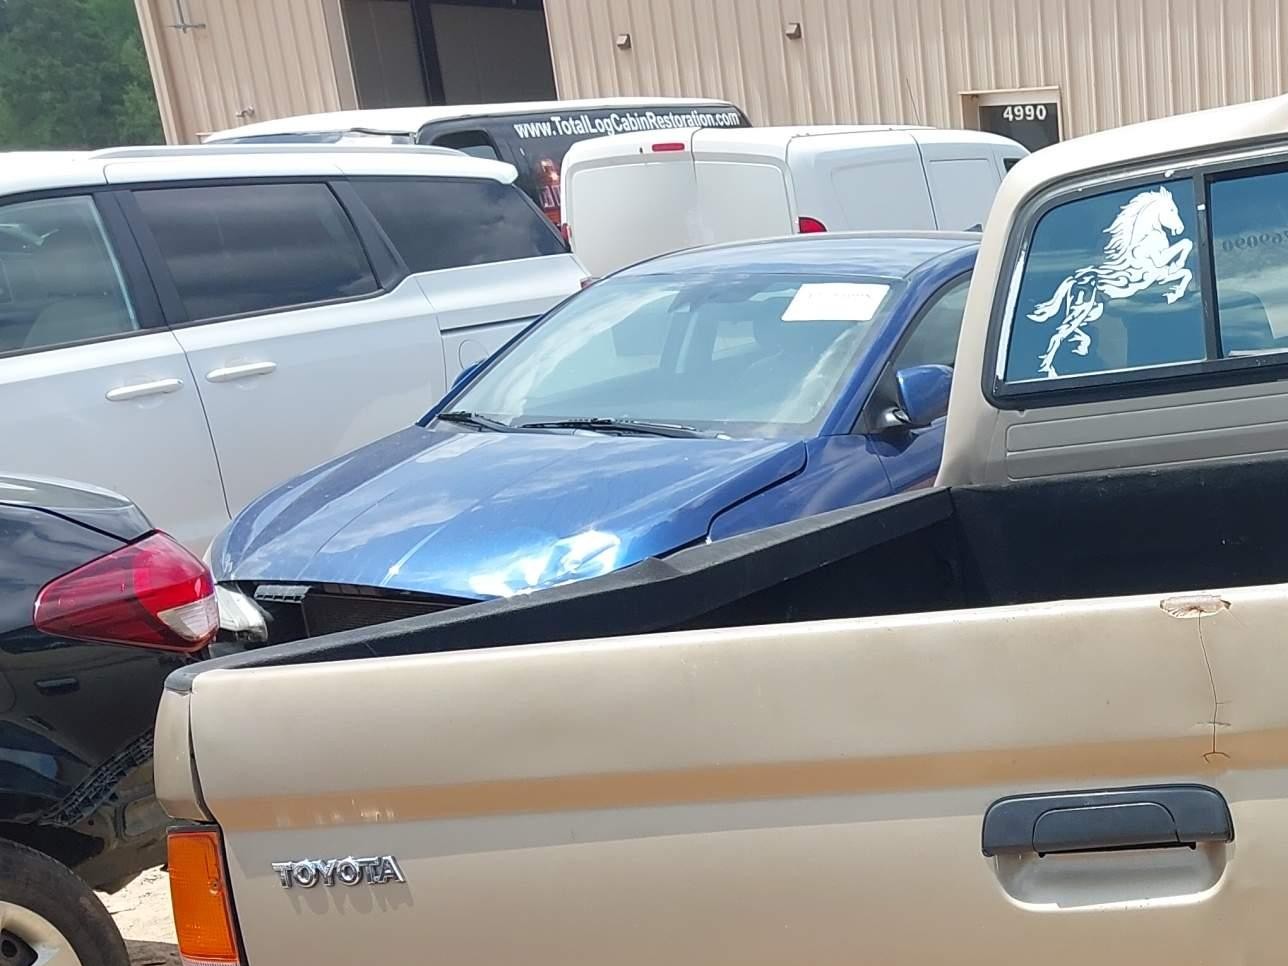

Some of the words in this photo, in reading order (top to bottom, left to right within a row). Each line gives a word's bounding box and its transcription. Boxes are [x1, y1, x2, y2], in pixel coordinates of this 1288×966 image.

[514, 110, 740, 139] www.TotalLogCabinRestoration.com
[1003, 104, 1047, 121] 4990
[271, 855, 406, 889] TOYOTA
